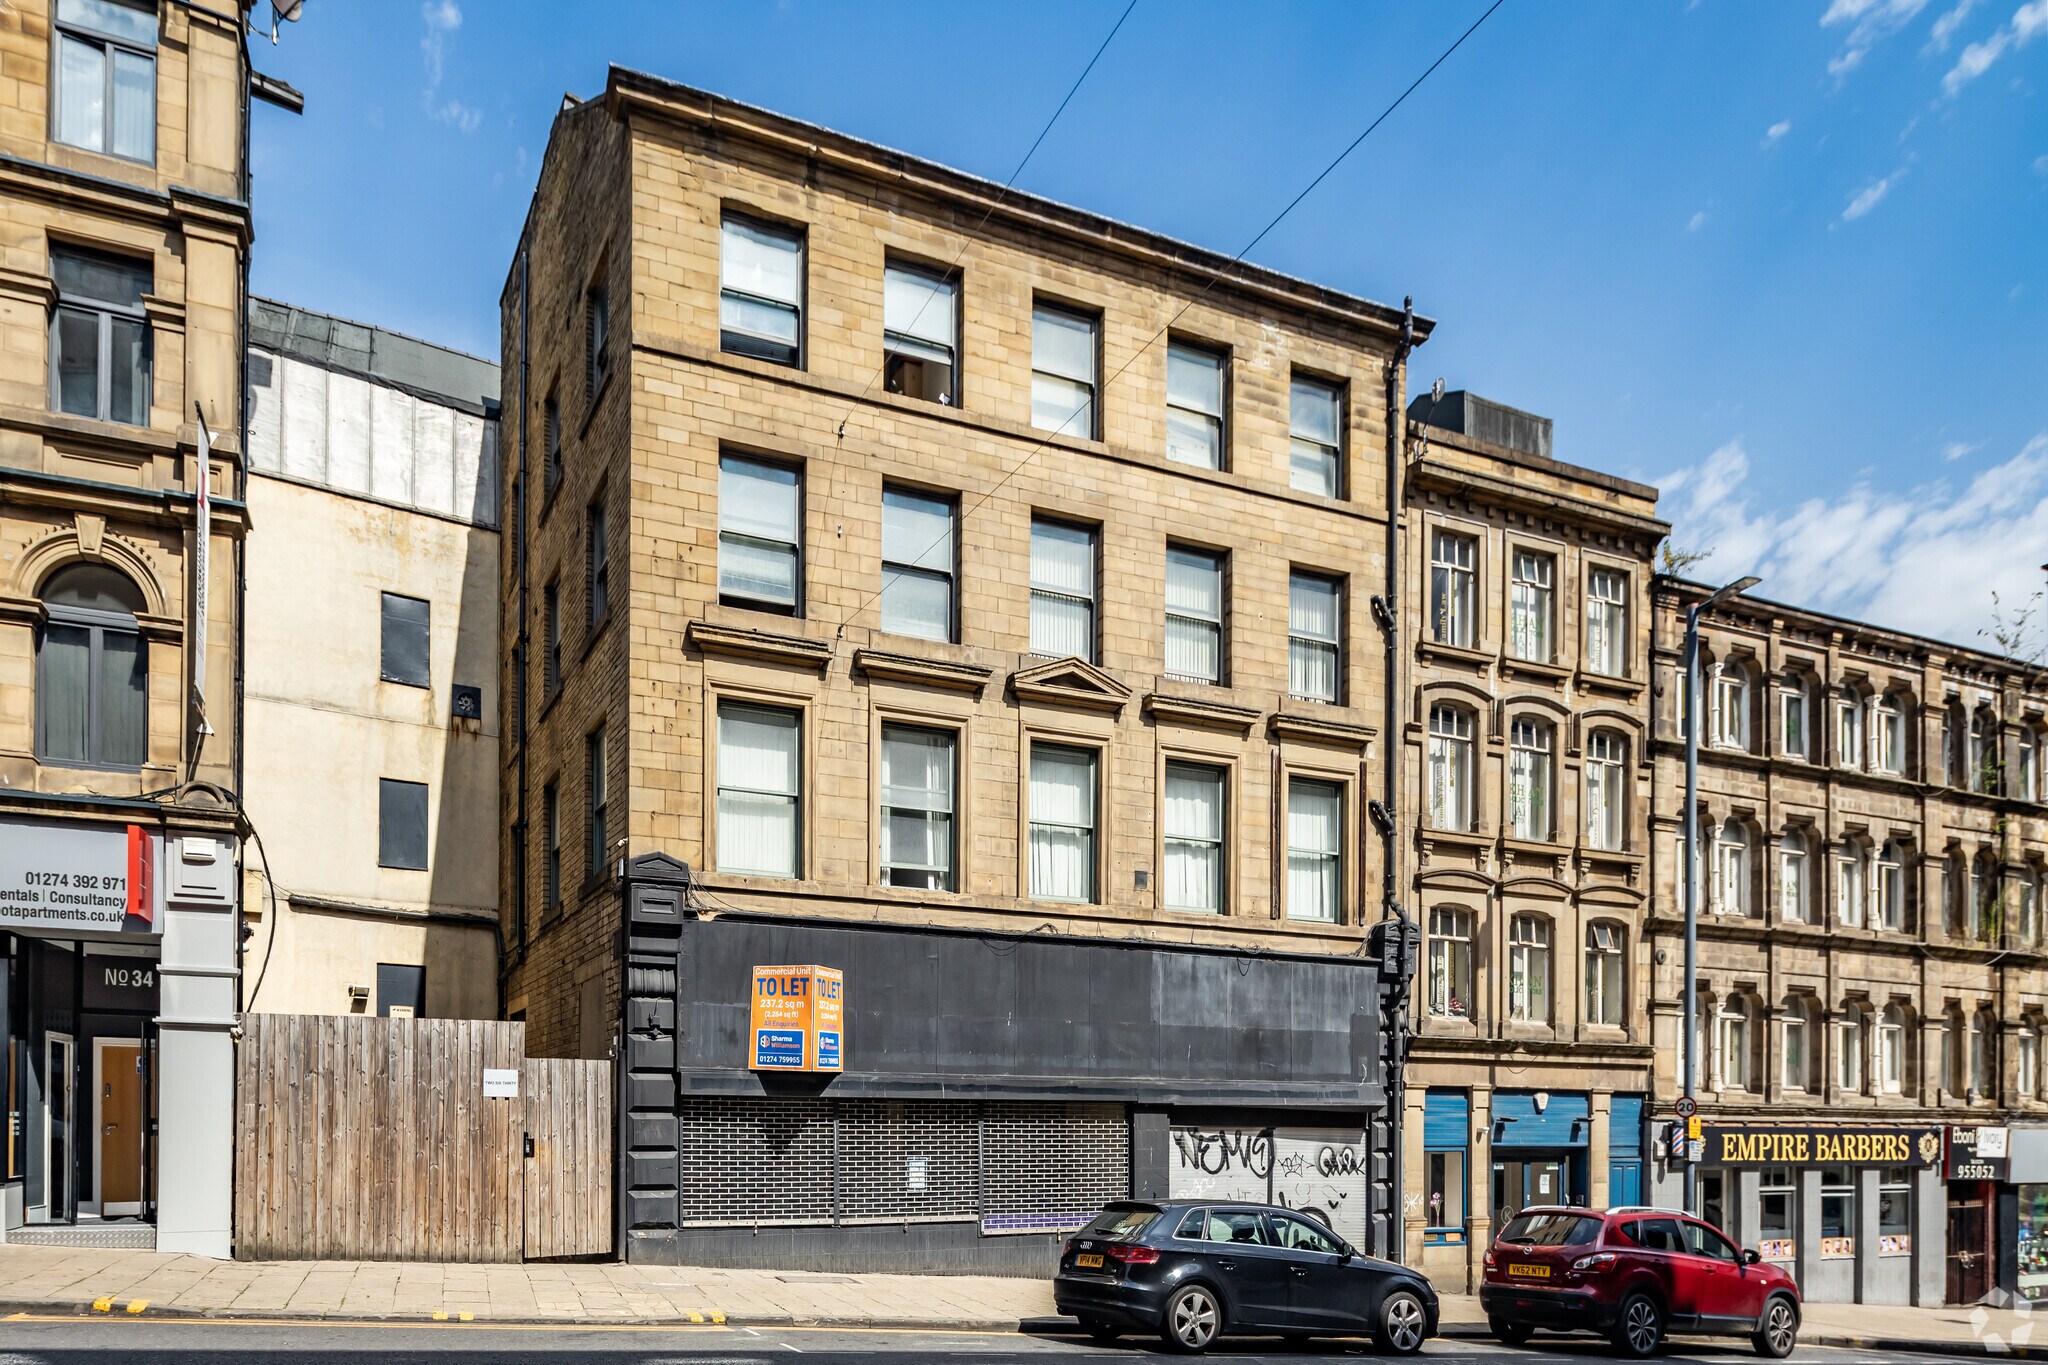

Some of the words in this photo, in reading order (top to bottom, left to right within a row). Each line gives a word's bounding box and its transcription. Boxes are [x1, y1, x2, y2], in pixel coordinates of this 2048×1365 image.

[25, 871, 69, 887] 01274
[73, 875, 98, 889] 392
[102, 877, 126, 891] 971
[49, 891, 126, 909] Consultancy
[0, 905, 125, 922] otapartments.co.uk
[131, 970, 153, 987] 34
[755, 967, 796, 976] Commercial
[797, 967, 811, 975] Unit
[756, 977, 777, 996] TO
[781, 977, 810, 996] LET
[817, 978, 826, 997] TO
[827, 980, 841, 999] LET
[760, 1000, 784, 1008] 237.2
[785, 1001, 795, 1009] sq
[772, 1020, 799, 1028] Enquiries
[759, 1055, 777, 1063] 01274
[1678, 1102, 1694, 1112] 20
[1952, 1126, 1976, 1144] Eboni
[1721, 1133, 1810, 1161] EMPIRE
[1815, 1134, 1910, 1161] BARBERS
[1957, 1165, 1995, 1179] 955052
[1512, 1265, 1530, 1275] VK62
[1531, 1267, 1547, 1276] NTV
